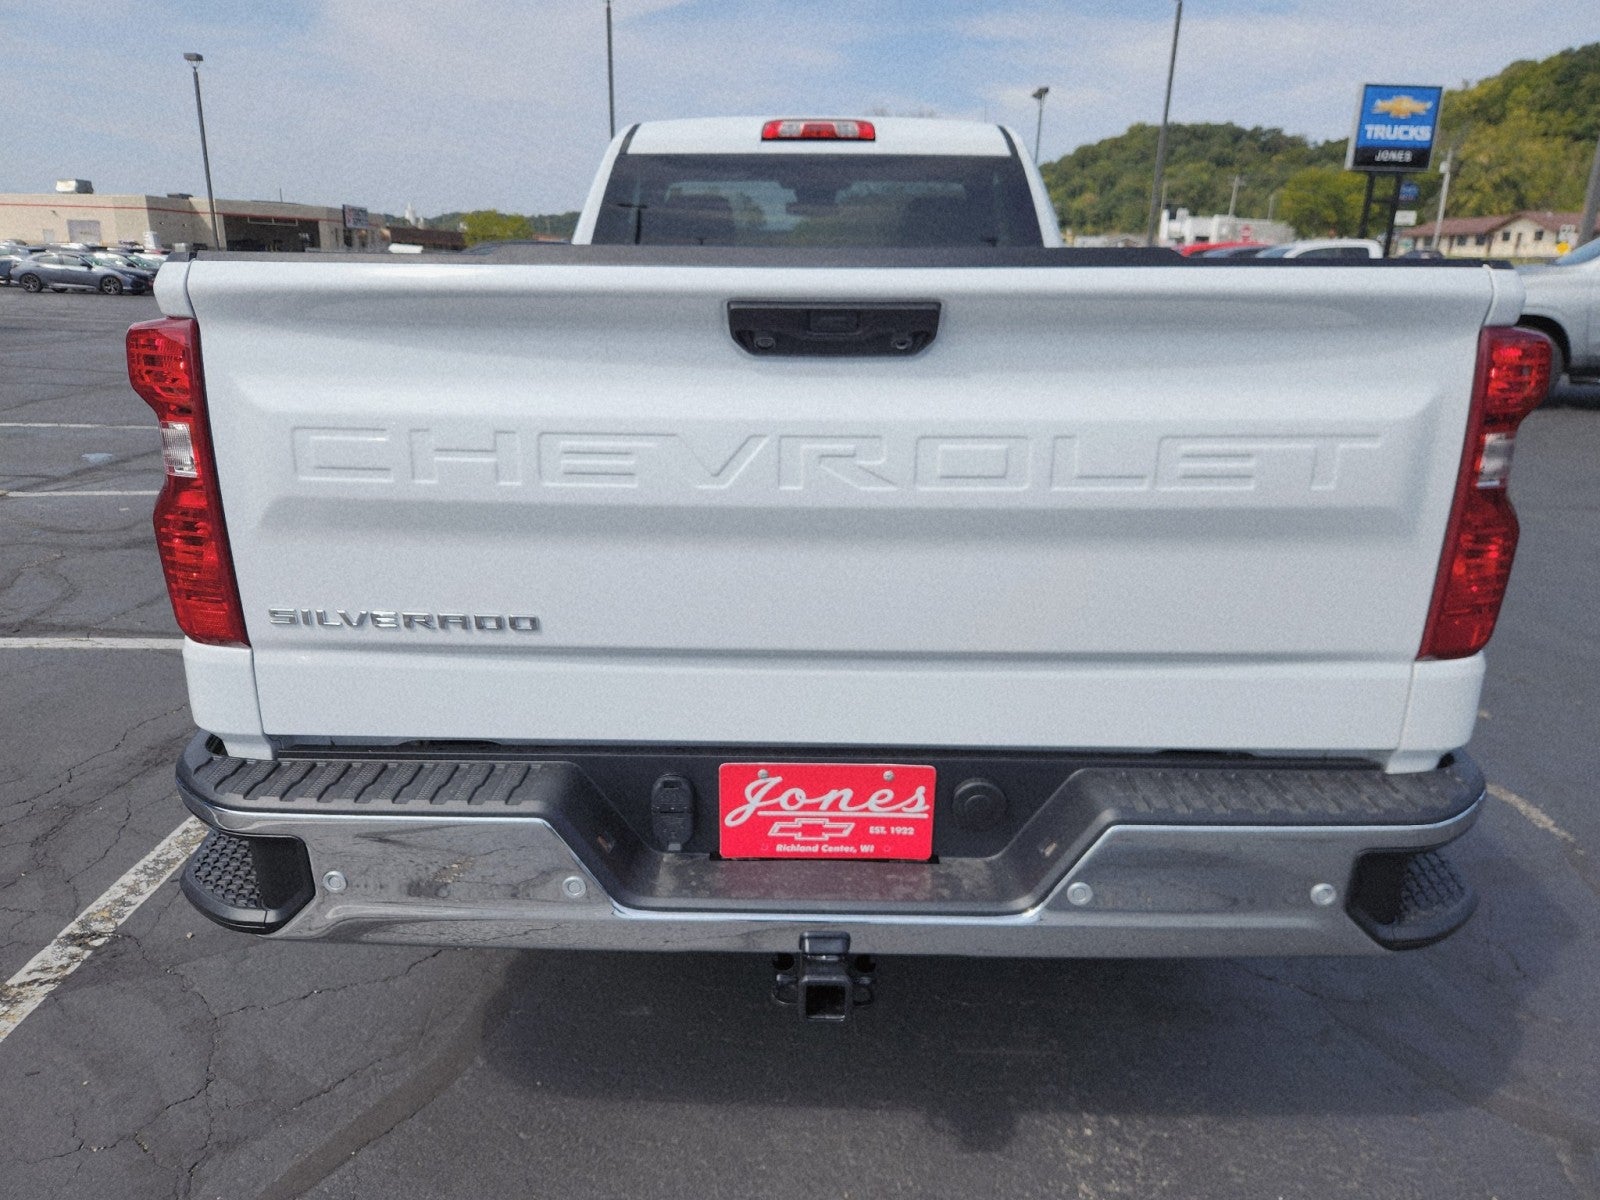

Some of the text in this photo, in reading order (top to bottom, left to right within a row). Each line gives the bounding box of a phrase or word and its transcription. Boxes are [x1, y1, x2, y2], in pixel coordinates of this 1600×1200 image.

[1365, 124, 1432, 141] TRUCKS
[1374, 149, 1413, 163] JONES
[292, 426, 1384, 492] CHEVROLET
[268, 608, 541, 631] SILVERADO
[724, 776, 930, 827] Jones
[869, 826, 888, 836] EST.
[776, 844, 875, 853] Richland Center, WI
